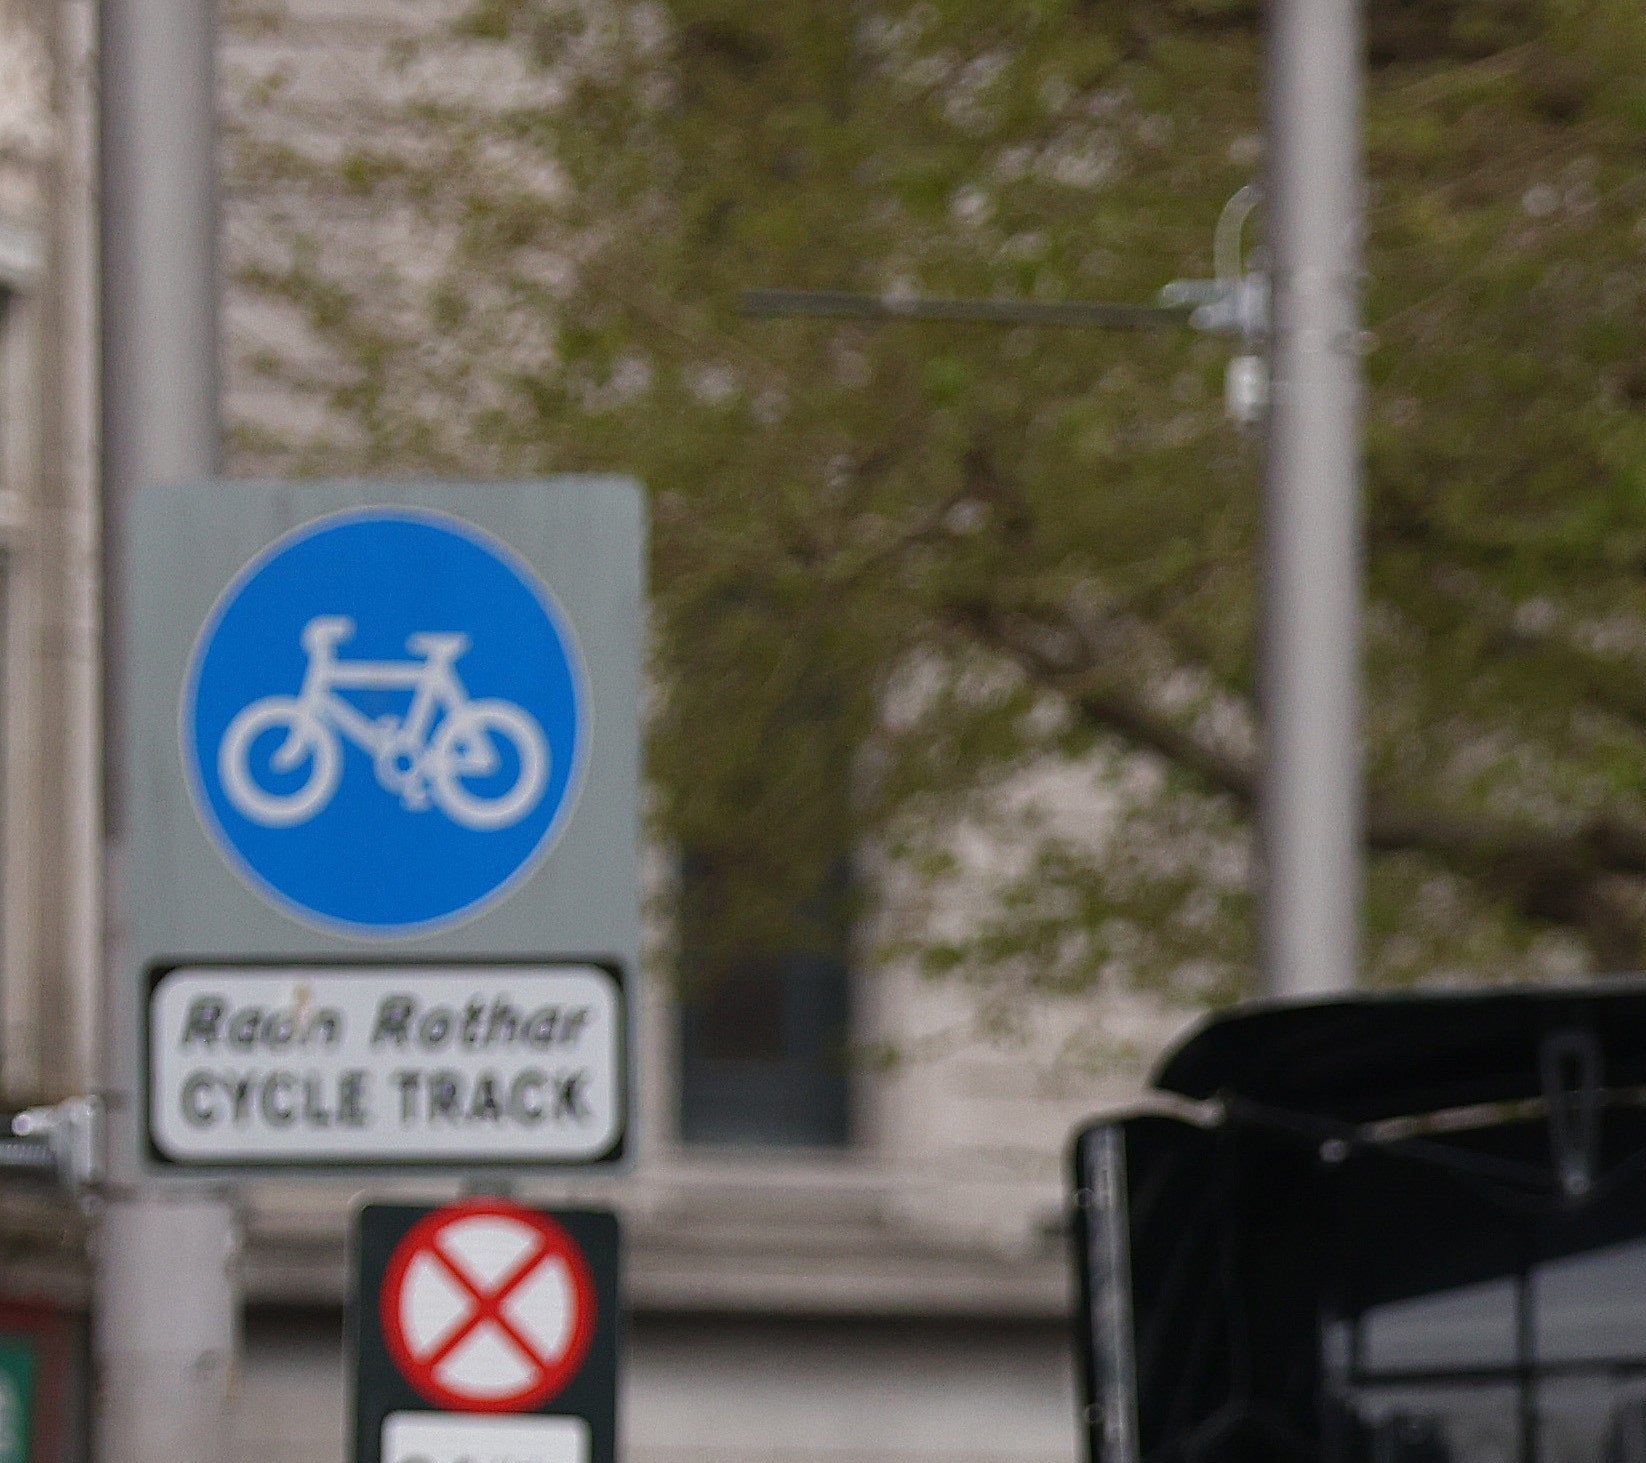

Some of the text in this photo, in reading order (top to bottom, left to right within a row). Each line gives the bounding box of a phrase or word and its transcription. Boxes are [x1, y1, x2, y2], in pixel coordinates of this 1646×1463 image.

[371, 996, 591, 1050] Rothar
[180, 1069, 591, 1127] CYCLE TRACK
